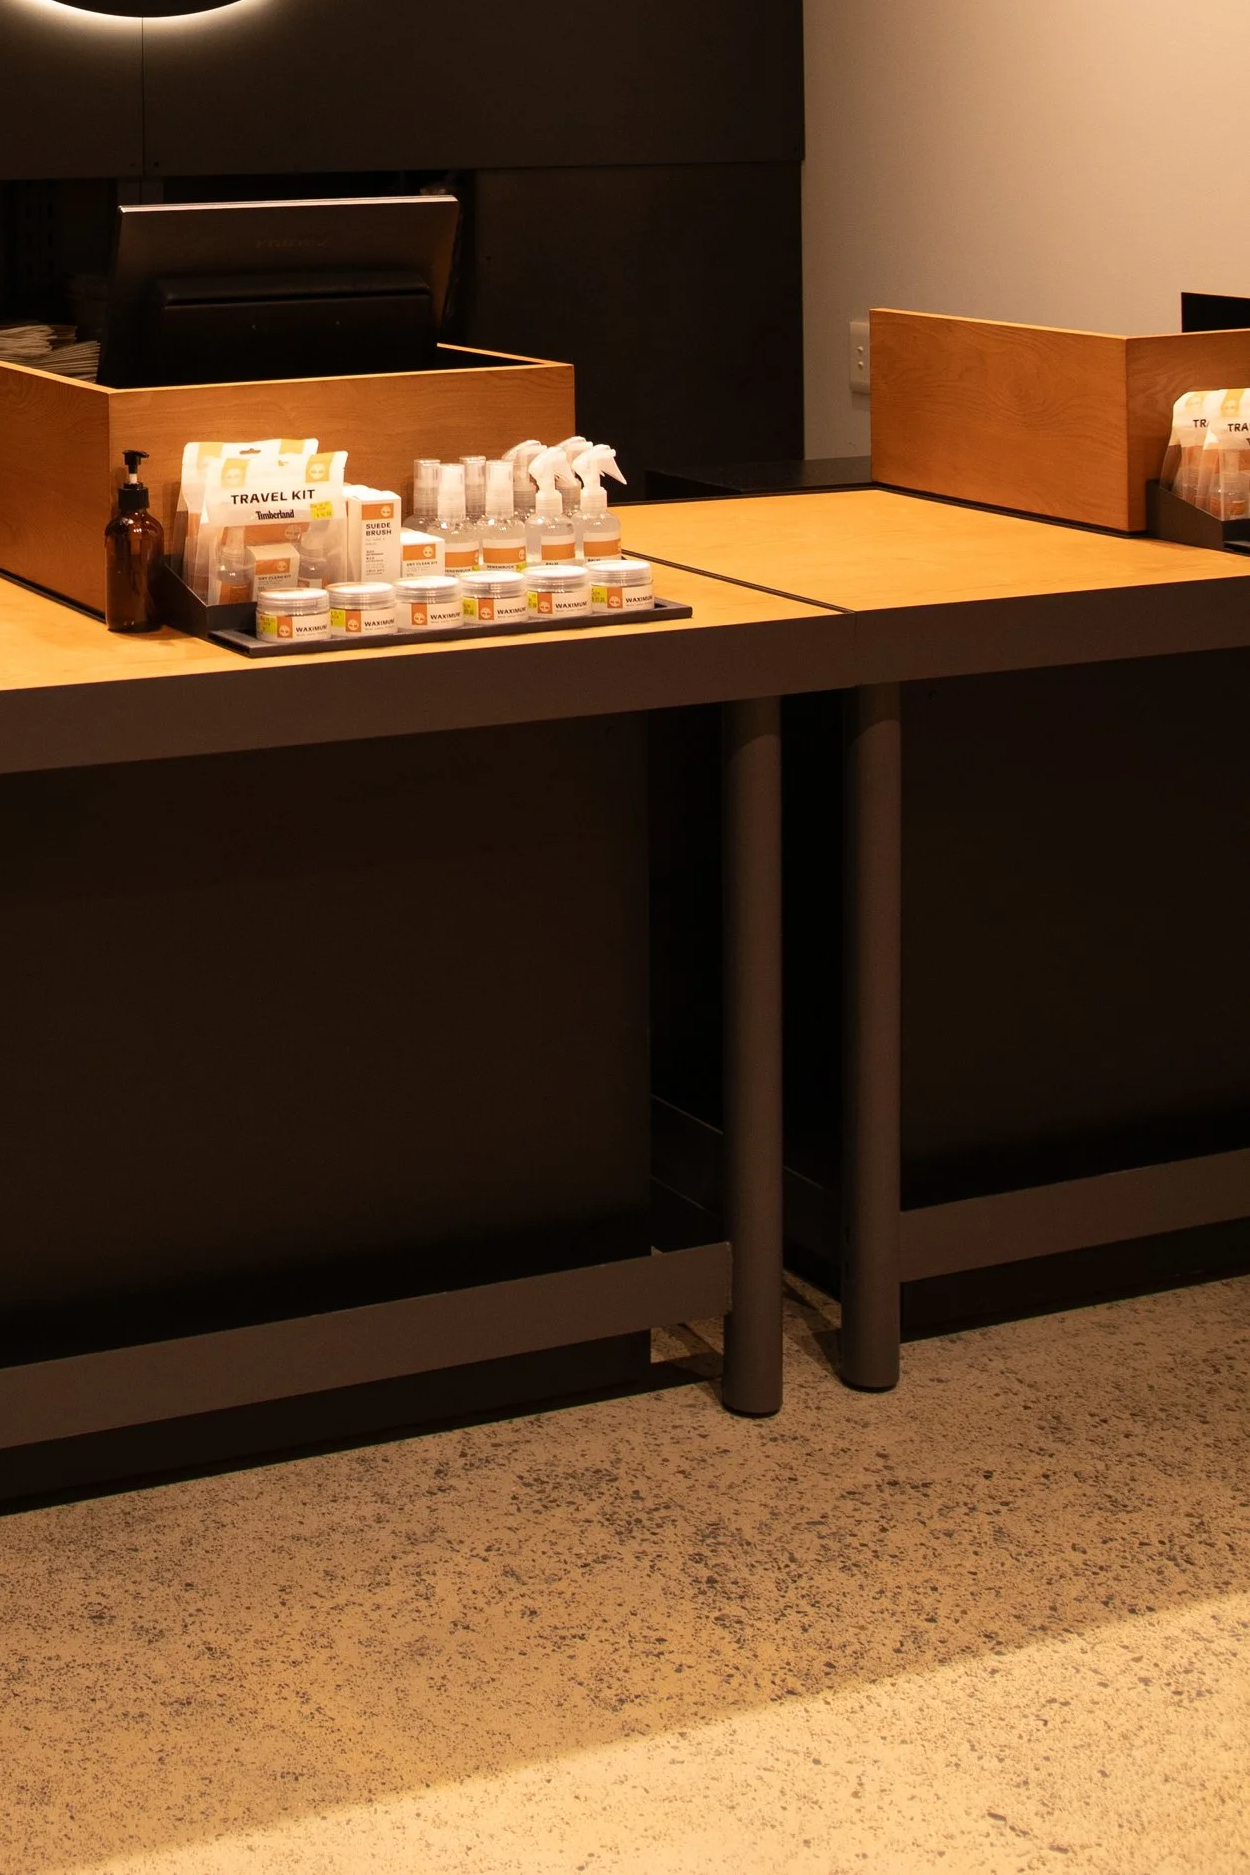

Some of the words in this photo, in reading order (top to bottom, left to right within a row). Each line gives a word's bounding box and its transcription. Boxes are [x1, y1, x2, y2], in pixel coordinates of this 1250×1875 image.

[1192, 419, 1209, 428] TR
[231, 491, 288, 505] TRAVEL
[291, 488, 316, 501] KIT
[255, 508, 295, 521] Timberland
[366, 522, 391, 530] SUEDE
[366, 528, 392, 537] BRUSH
